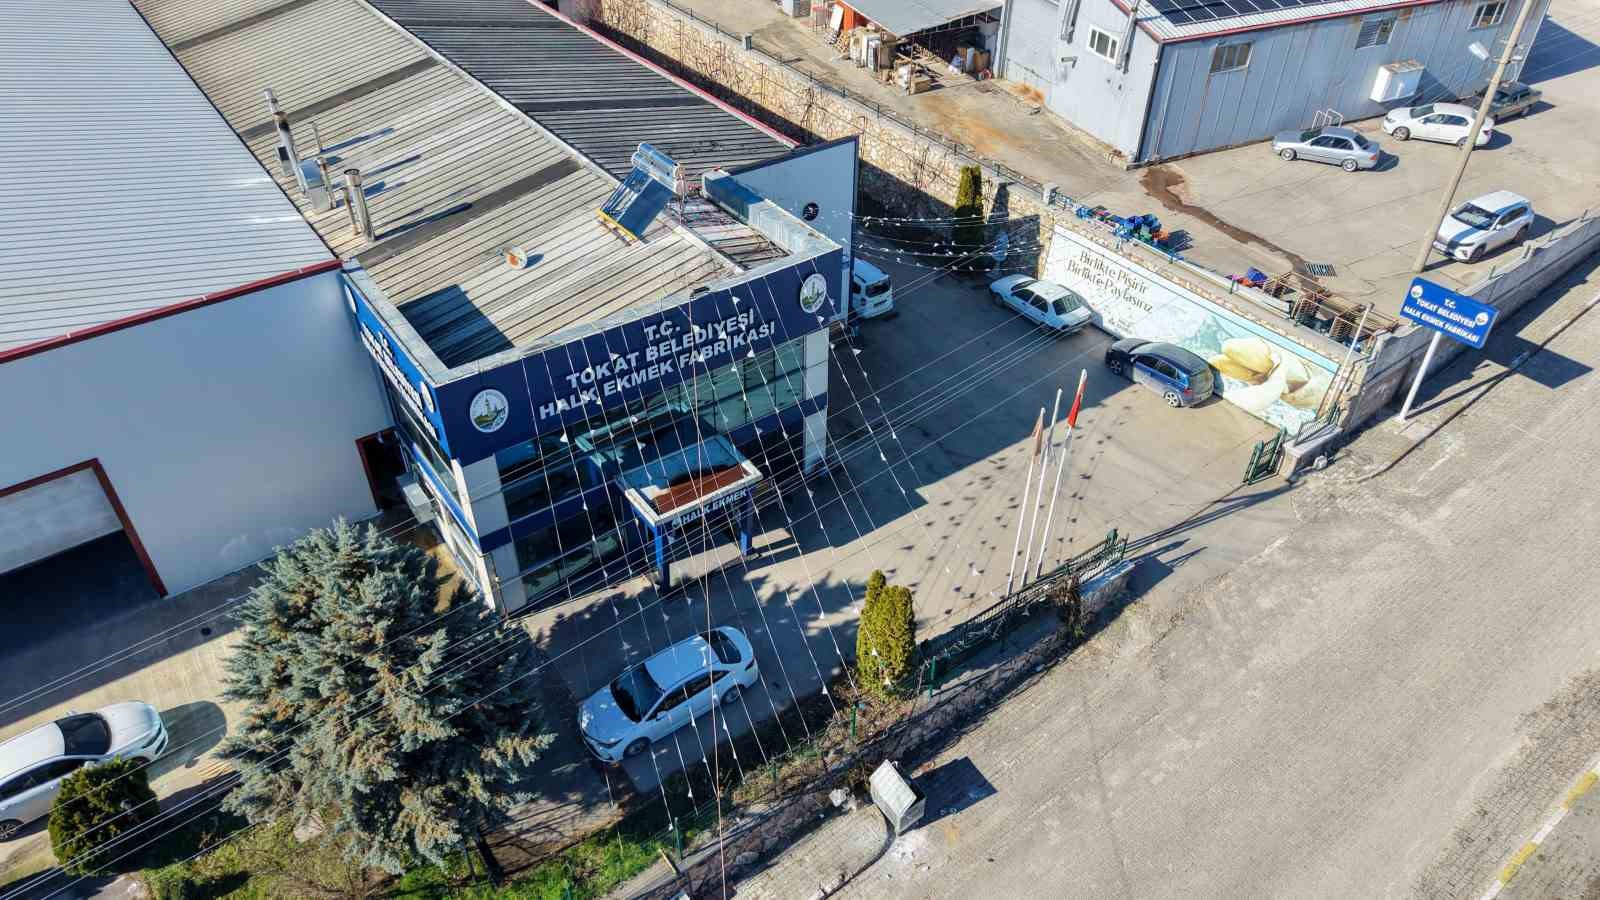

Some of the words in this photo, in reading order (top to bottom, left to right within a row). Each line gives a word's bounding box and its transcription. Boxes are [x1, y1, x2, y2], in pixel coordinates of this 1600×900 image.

[1067, 259, 1105, 287] Birlikte
[1080, 250, 1116, 277] Birlikte
[644, 320, 681, 341] T.C.
[539, 387, 598, 420] HALK
[603, 359, 674, 397] EKMEK
[680, 321, 775, 368] FABRİKASI
[566, 352, 639, 388] TOKAT
[682, 506, 711, 524] HALK
[712, 488, 747, 510] EKMEK
